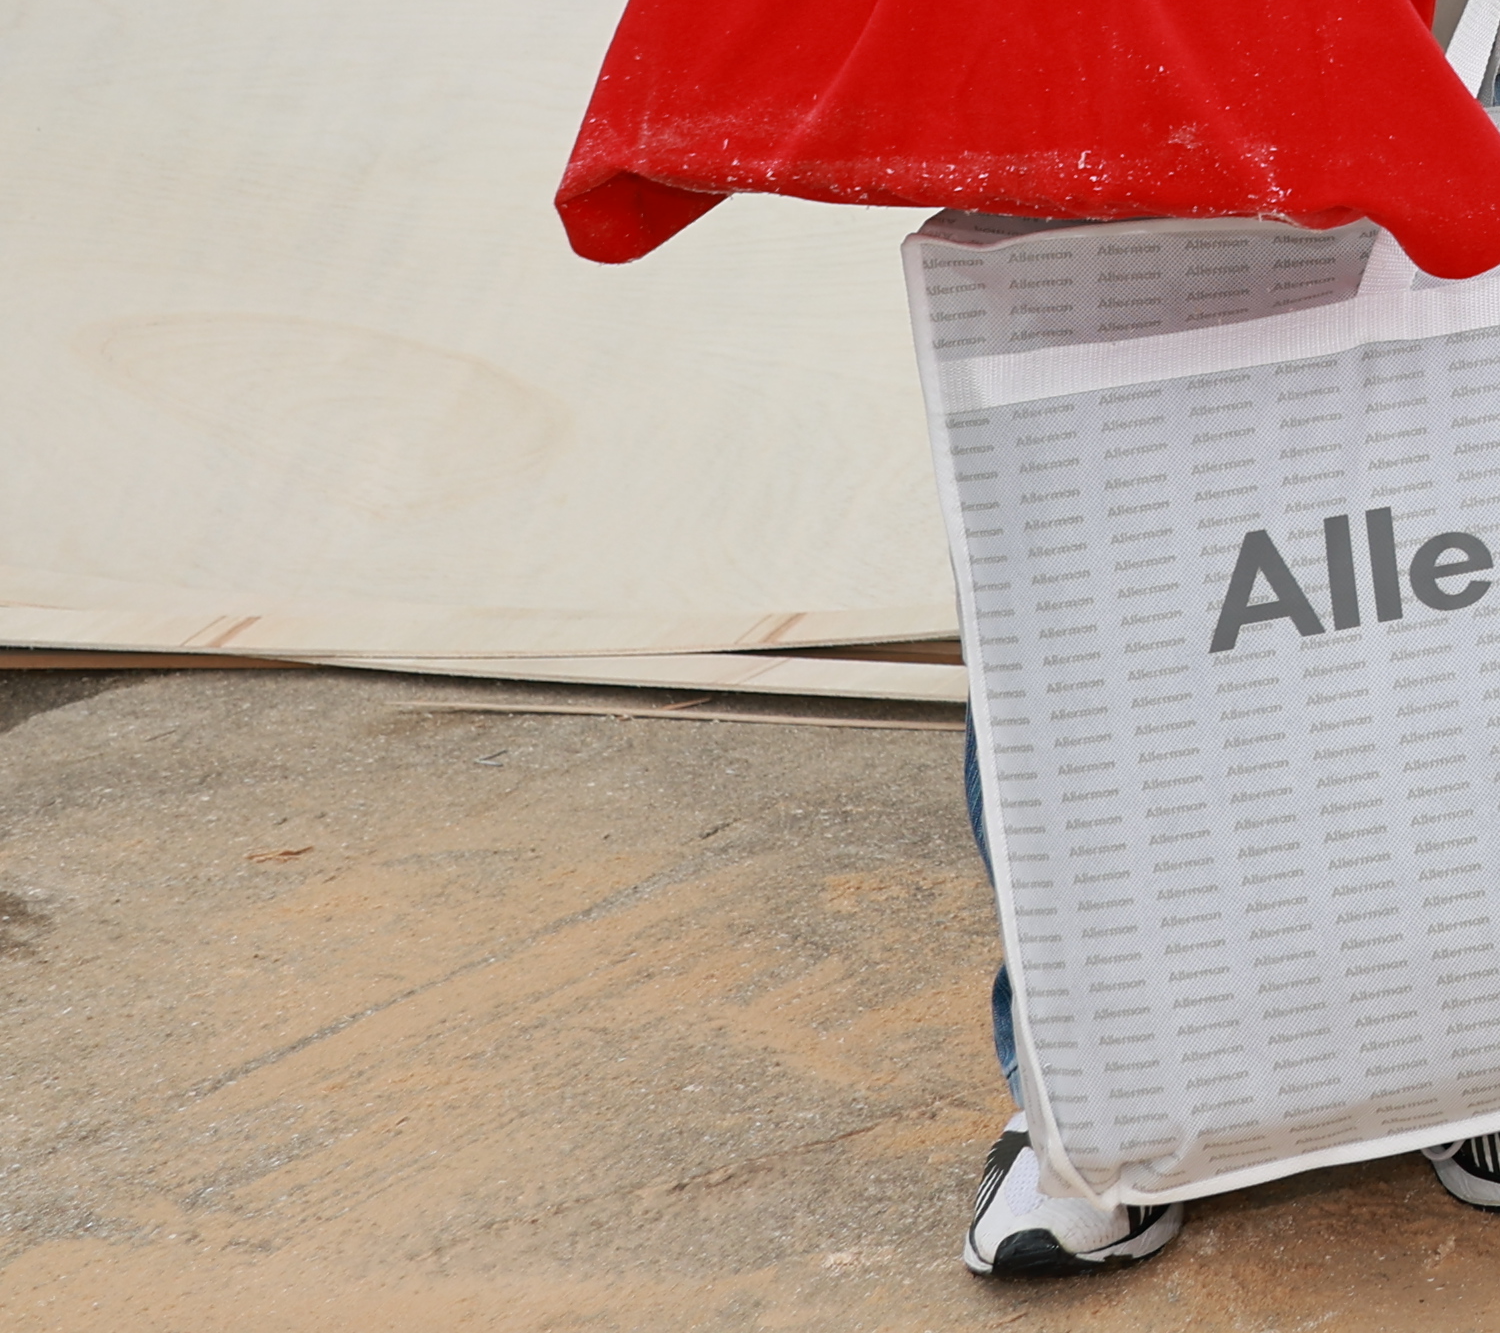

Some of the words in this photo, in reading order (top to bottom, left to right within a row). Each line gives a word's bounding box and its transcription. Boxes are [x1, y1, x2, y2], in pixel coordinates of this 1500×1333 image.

[1096, 243, 1162, 257] Allerman
[1184, 287, 1251, 303] Allerman
[1009, 301, 1074, 316] Allerman
[1276, 385, 1341, 404] Allerman
[1100, 414, 1166, 434] Allerman
[1367, 452, 1431, 472] Allerman
[1193, 483, 1259, 504] Allerman
[1022, 514, 1085, 533] Allerman
[1034, 596, 1095, 613] Allerman
[1123, 636, 1187, 655] Allerman
[1301, 659, 1368, 680] Allerman
[1049, 704, 1110, 723] Allerman
[1395, 697, 1460, 718] Allerman
[1225, 758, 1291, 778] Allerman
[1060, 787, 1121, 805] Allerman
[1327, 851, 1392, 872] Allerman
[1155, 883, 1221, 902] Allerman
[1421, 888, 1487, 910] Allerman
[1252, 949, 1318, 969] Allerman
[1092, 1005, 1152, 1022] Allerman
[1359, 1033, 1424, 1054] Allerman
[1185, 1069, 1250, 1091] Allerman
